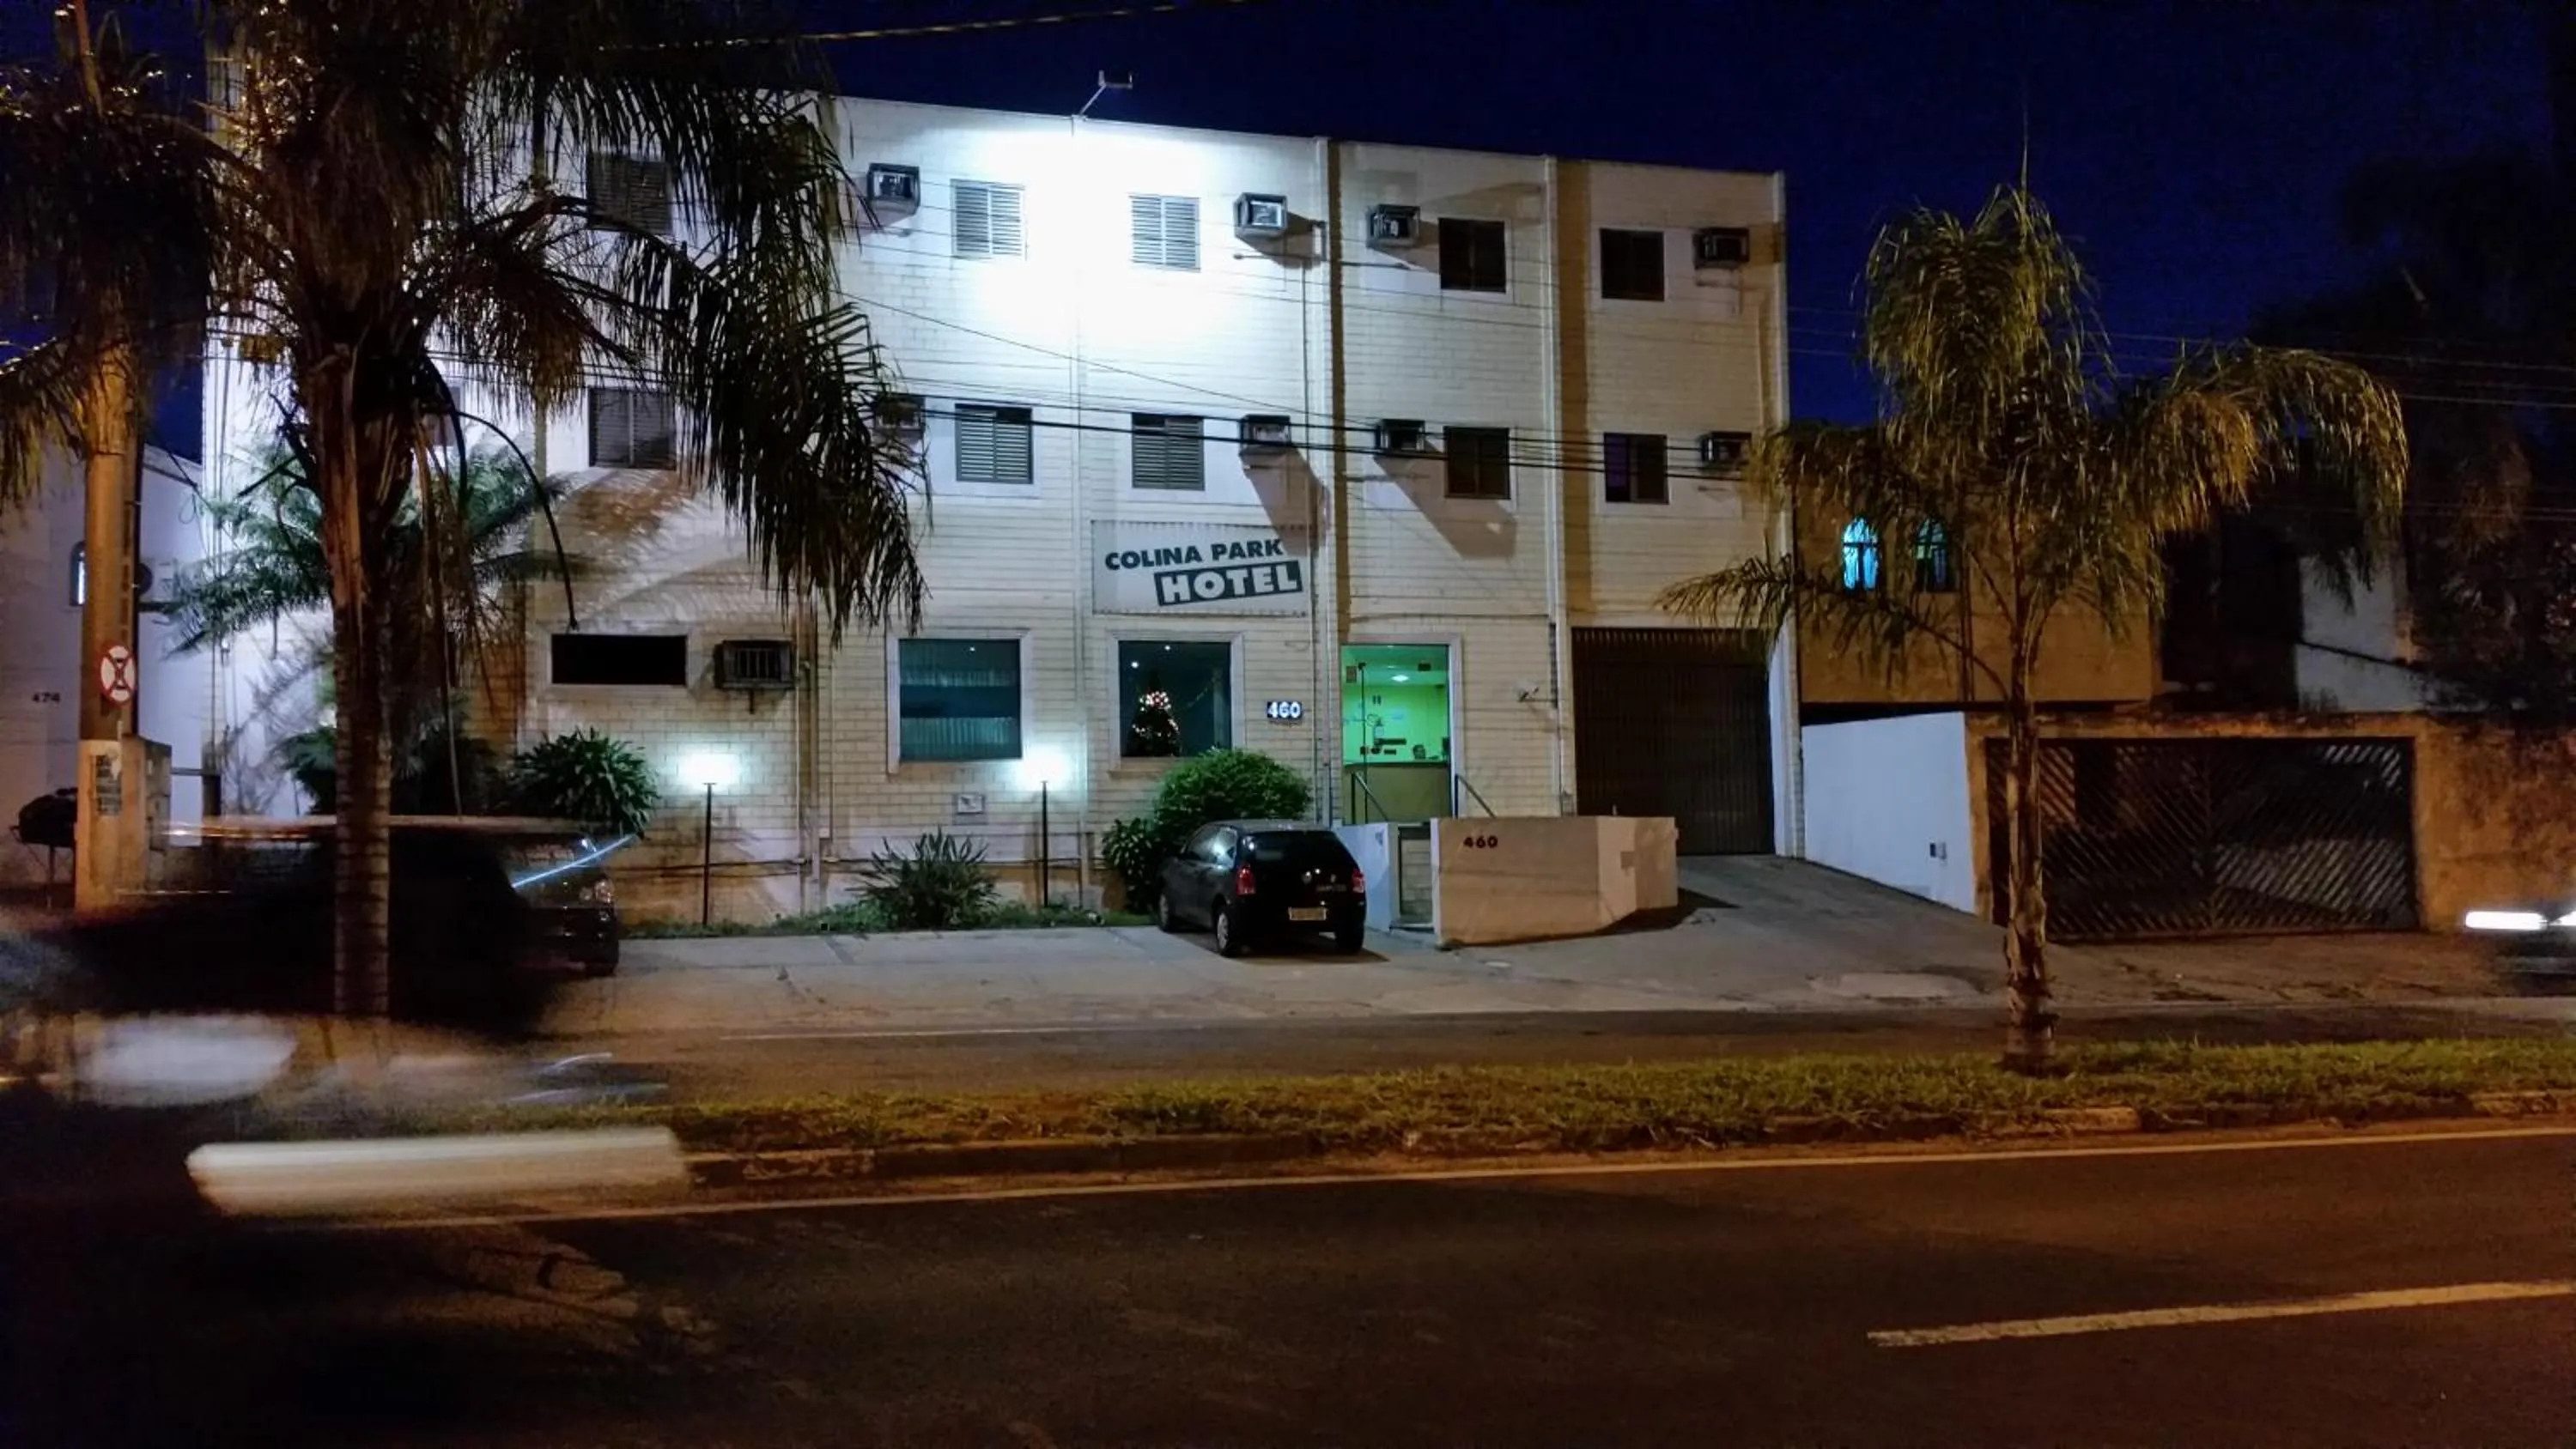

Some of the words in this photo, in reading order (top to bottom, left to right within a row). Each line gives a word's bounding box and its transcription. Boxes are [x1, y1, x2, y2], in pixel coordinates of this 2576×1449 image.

[1105, 547, 1202, 570] COLINA
[1211, 539, 1282, 561] PARK
[1161, 566, 1297, 603] HOTEL
[1268, 701, 1301, 718] 460
[1464, 835, 1498, 848] 460
